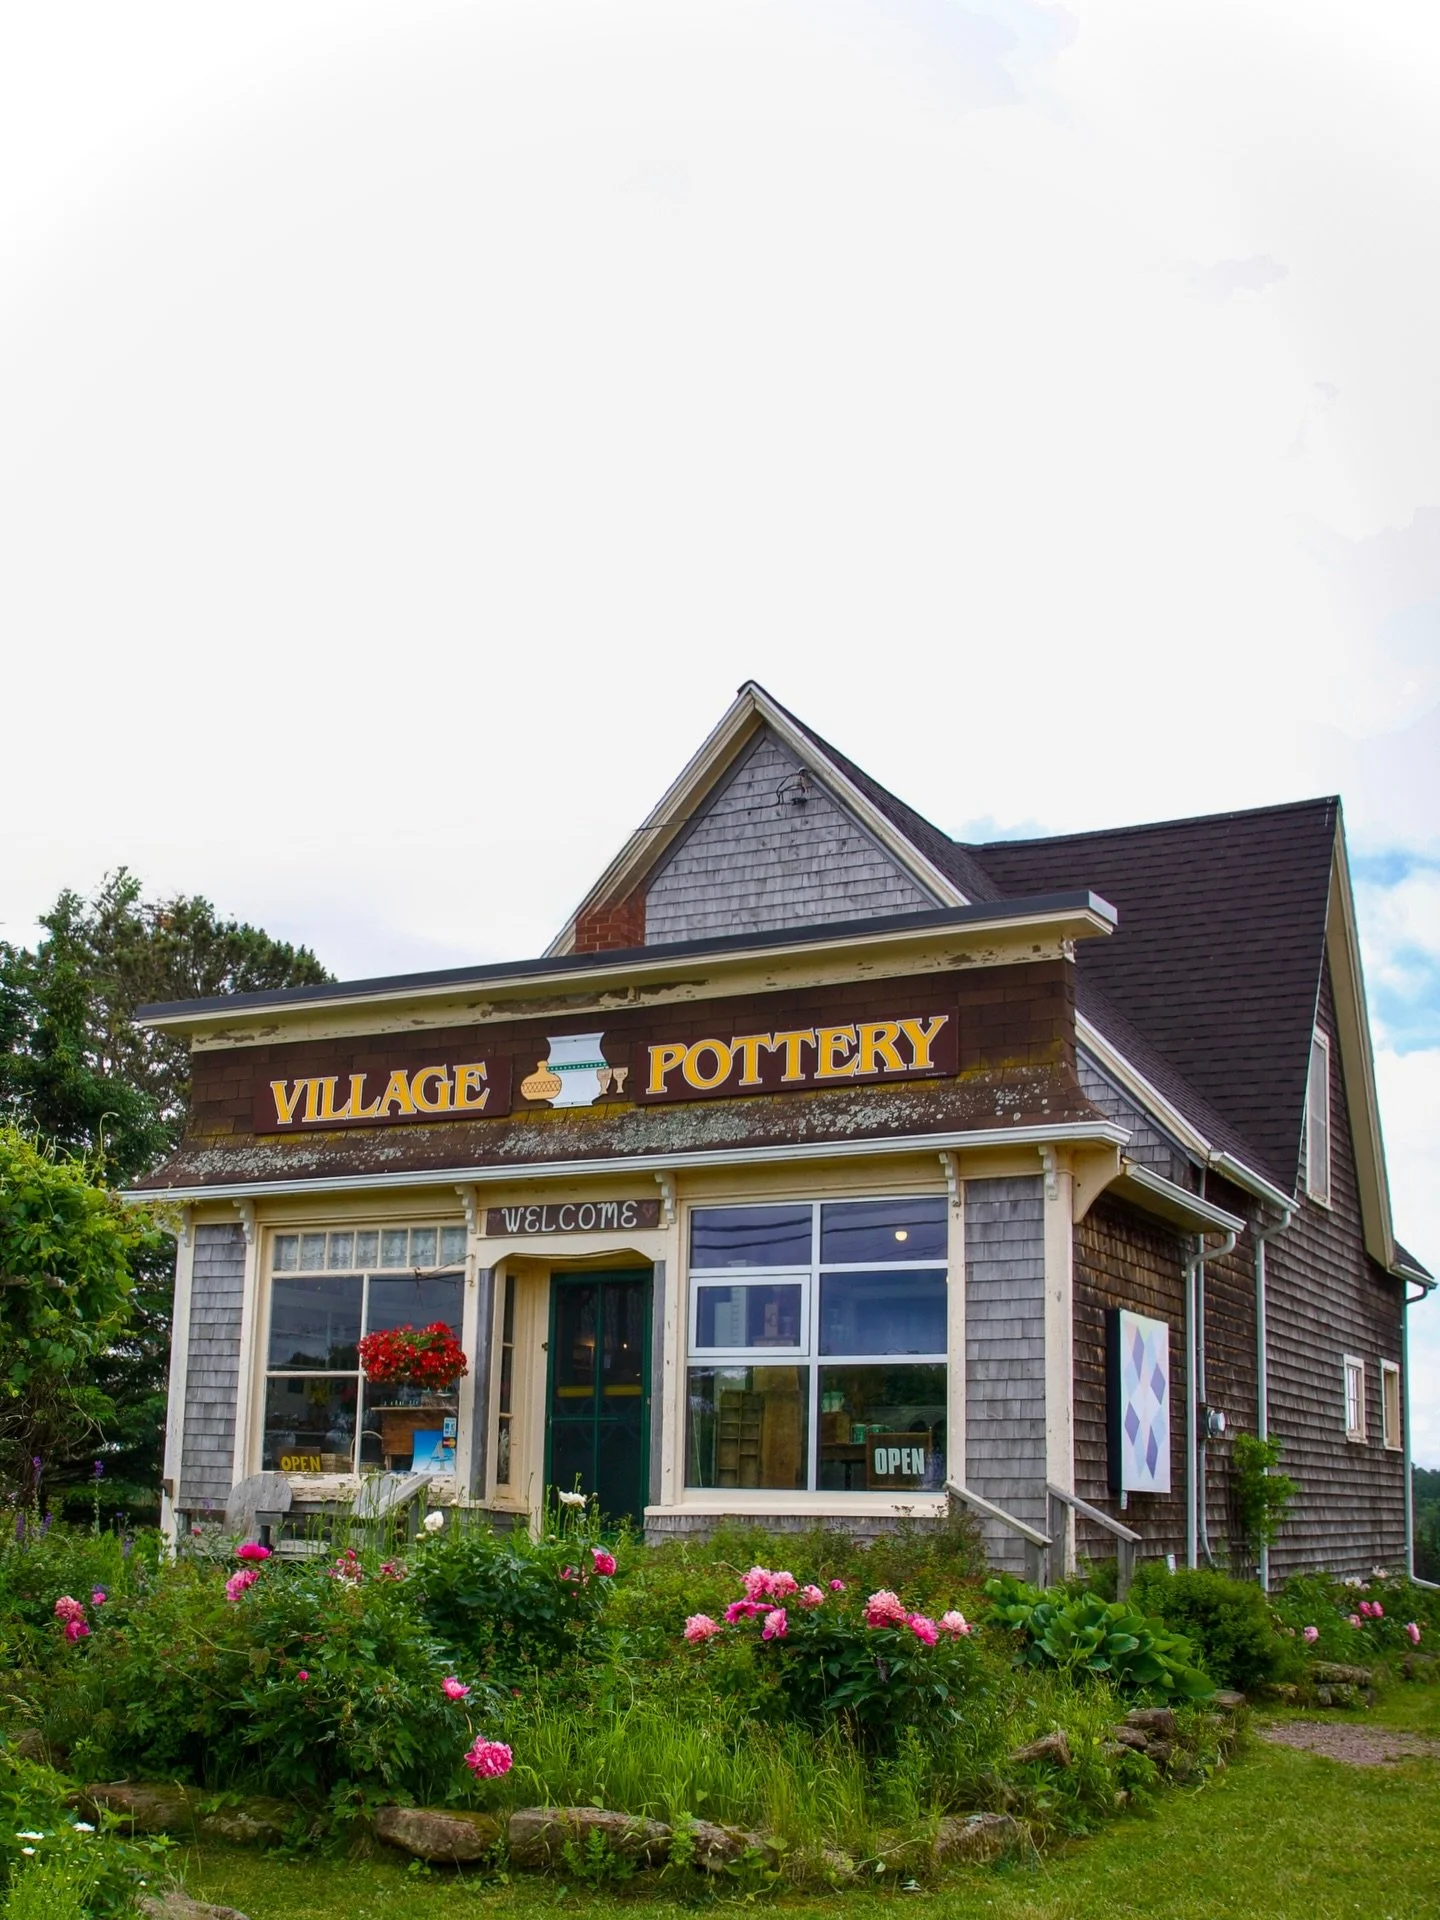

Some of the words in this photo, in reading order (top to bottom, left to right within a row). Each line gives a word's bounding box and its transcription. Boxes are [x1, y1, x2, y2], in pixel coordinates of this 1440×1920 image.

[270, 1061, 490, 1124] VILLAGE
[646, 1015, 949, 1094] POTTERY
[501, 1200, 638, 1233] WELCOME
[280, 1455, 321, 1472] OPEN
[874, 1448, 925, 1475] OPEN
